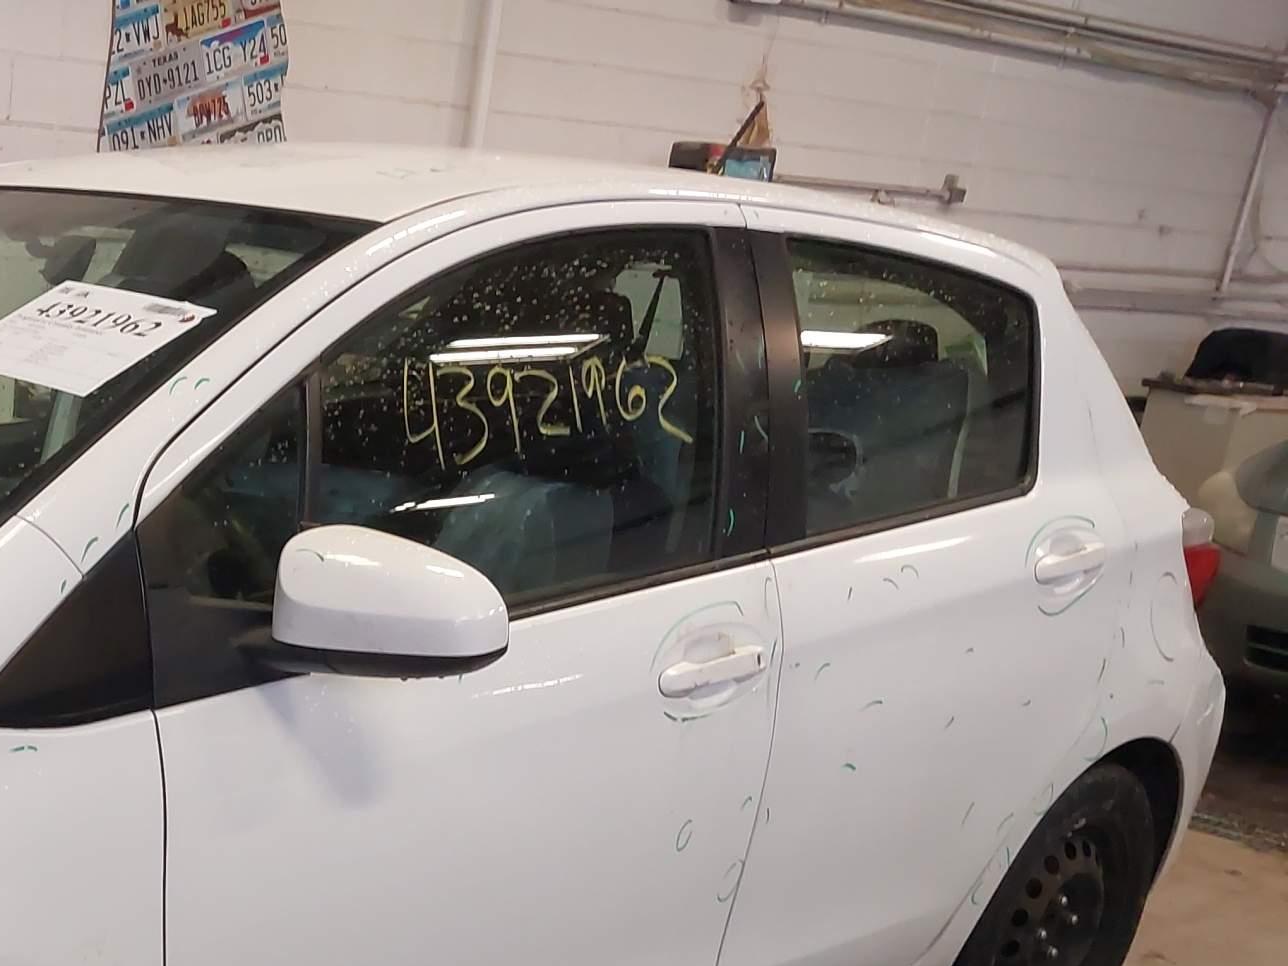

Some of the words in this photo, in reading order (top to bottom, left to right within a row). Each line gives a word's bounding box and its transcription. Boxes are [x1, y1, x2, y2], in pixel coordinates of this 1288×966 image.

[152, 51, 178, 68] TEXAS
[36, 301, 162, 337] 43921962
[403, 354, 693, 470] 43921962
